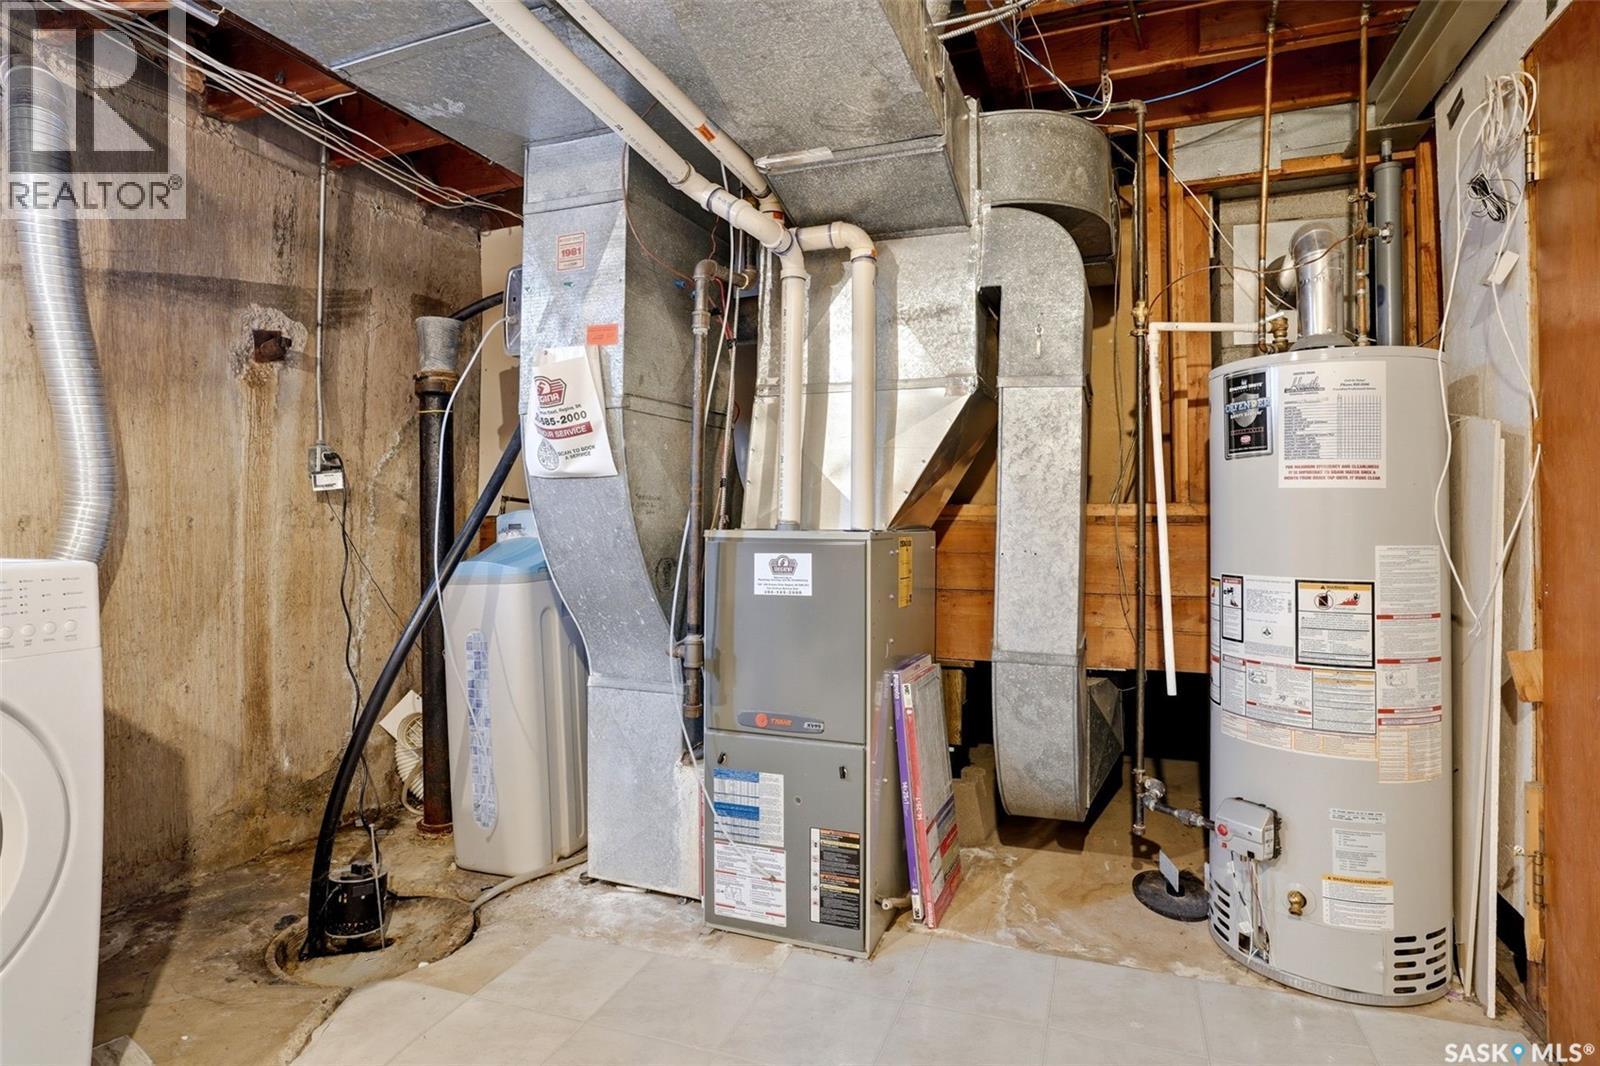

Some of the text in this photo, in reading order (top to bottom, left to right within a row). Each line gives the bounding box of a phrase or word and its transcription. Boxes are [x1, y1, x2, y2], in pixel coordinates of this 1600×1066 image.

[561, 247, 582, 257] 1981
[556, 425, 587, 437] SERVICE
[915, 908, 920, 918] 3M
